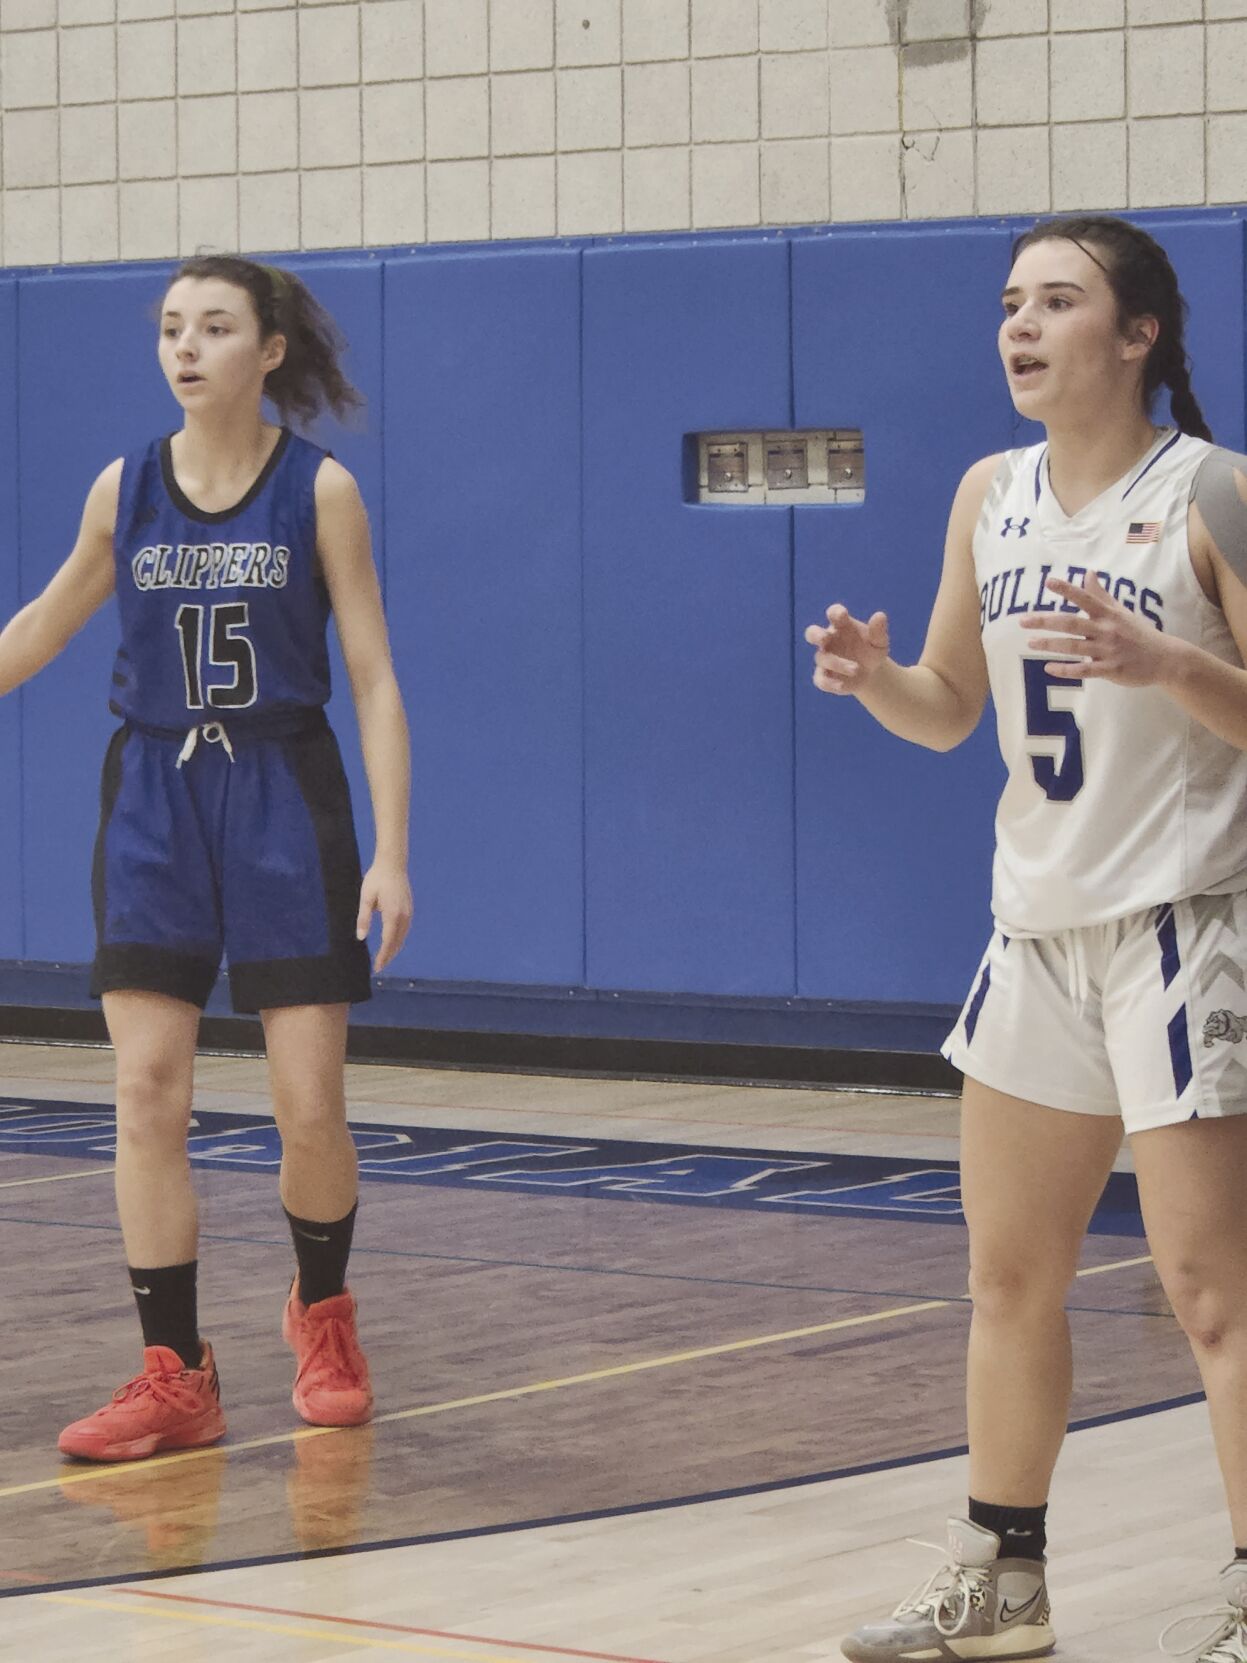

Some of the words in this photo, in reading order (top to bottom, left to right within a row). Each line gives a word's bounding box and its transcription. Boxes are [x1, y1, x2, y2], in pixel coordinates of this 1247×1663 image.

[132, 543, 290, 591] CLIPPERS
[174, 602, 258, 709] 15
[1020, 655, 1086, 804] 5
